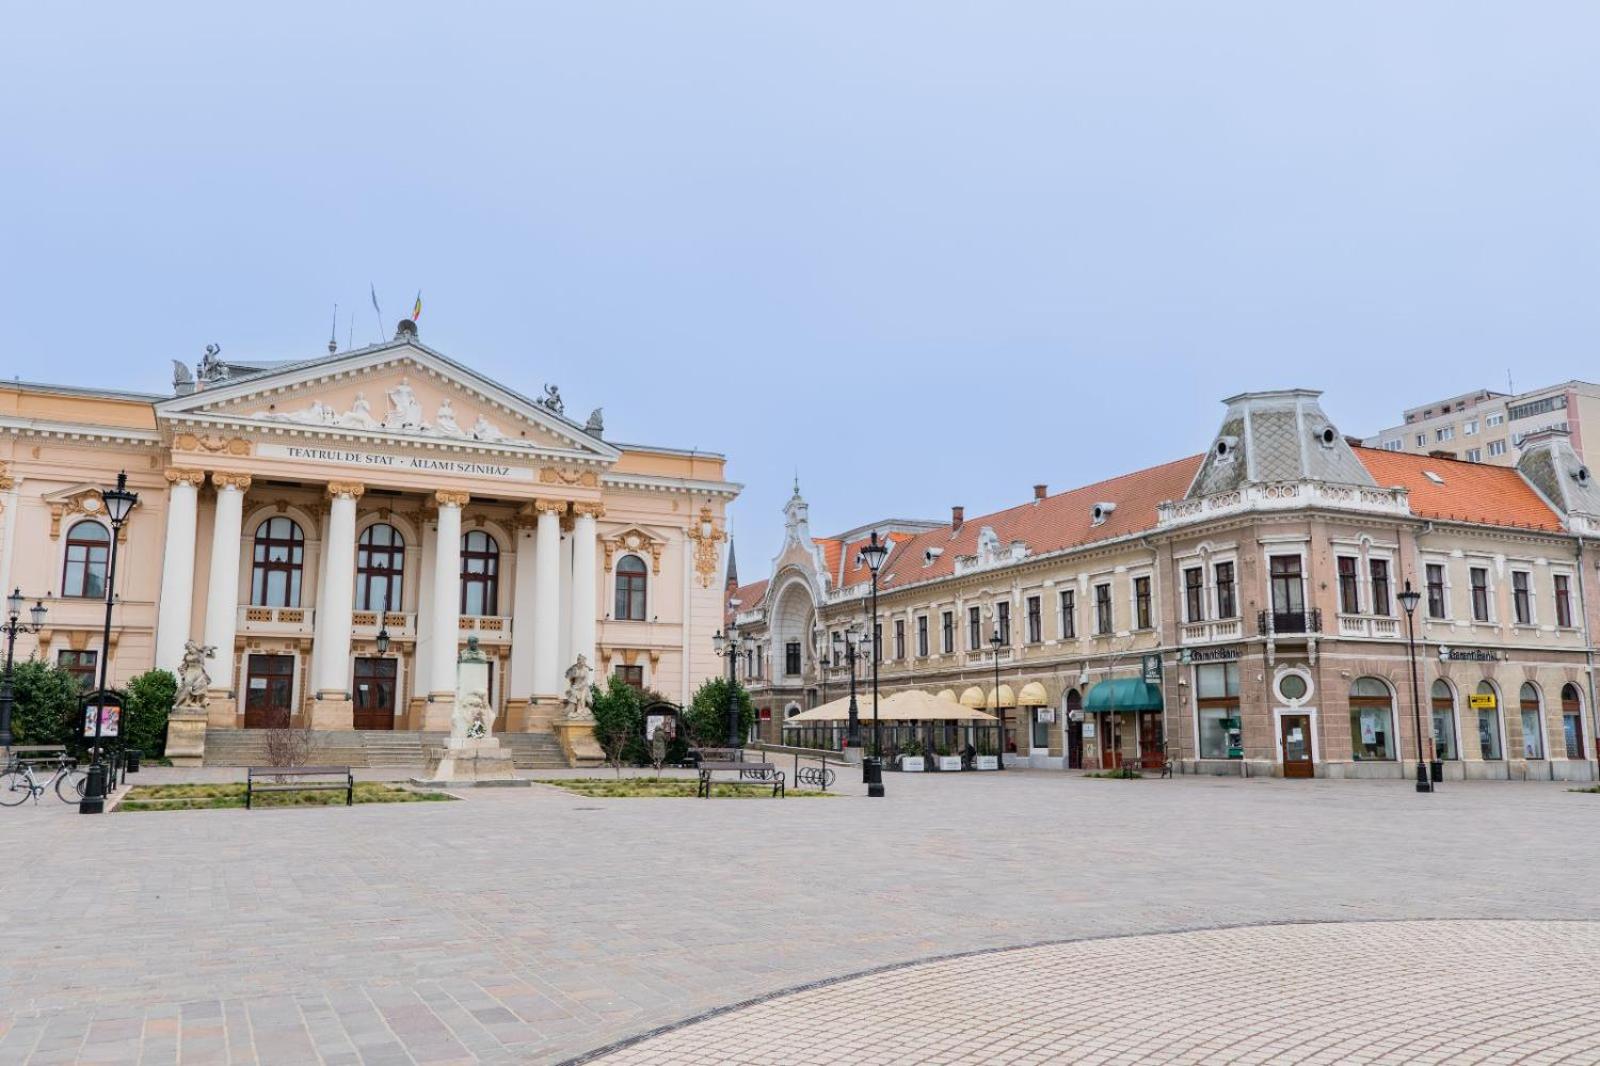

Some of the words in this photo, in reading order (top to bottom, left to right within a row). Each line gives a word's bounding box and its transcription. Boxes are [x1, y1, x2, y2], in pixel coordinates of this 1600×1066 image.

[287, 447, 343, 461] TEATRUL
[345, 452, 362, 463] DE
[365, 453, 396, 465] STAT
